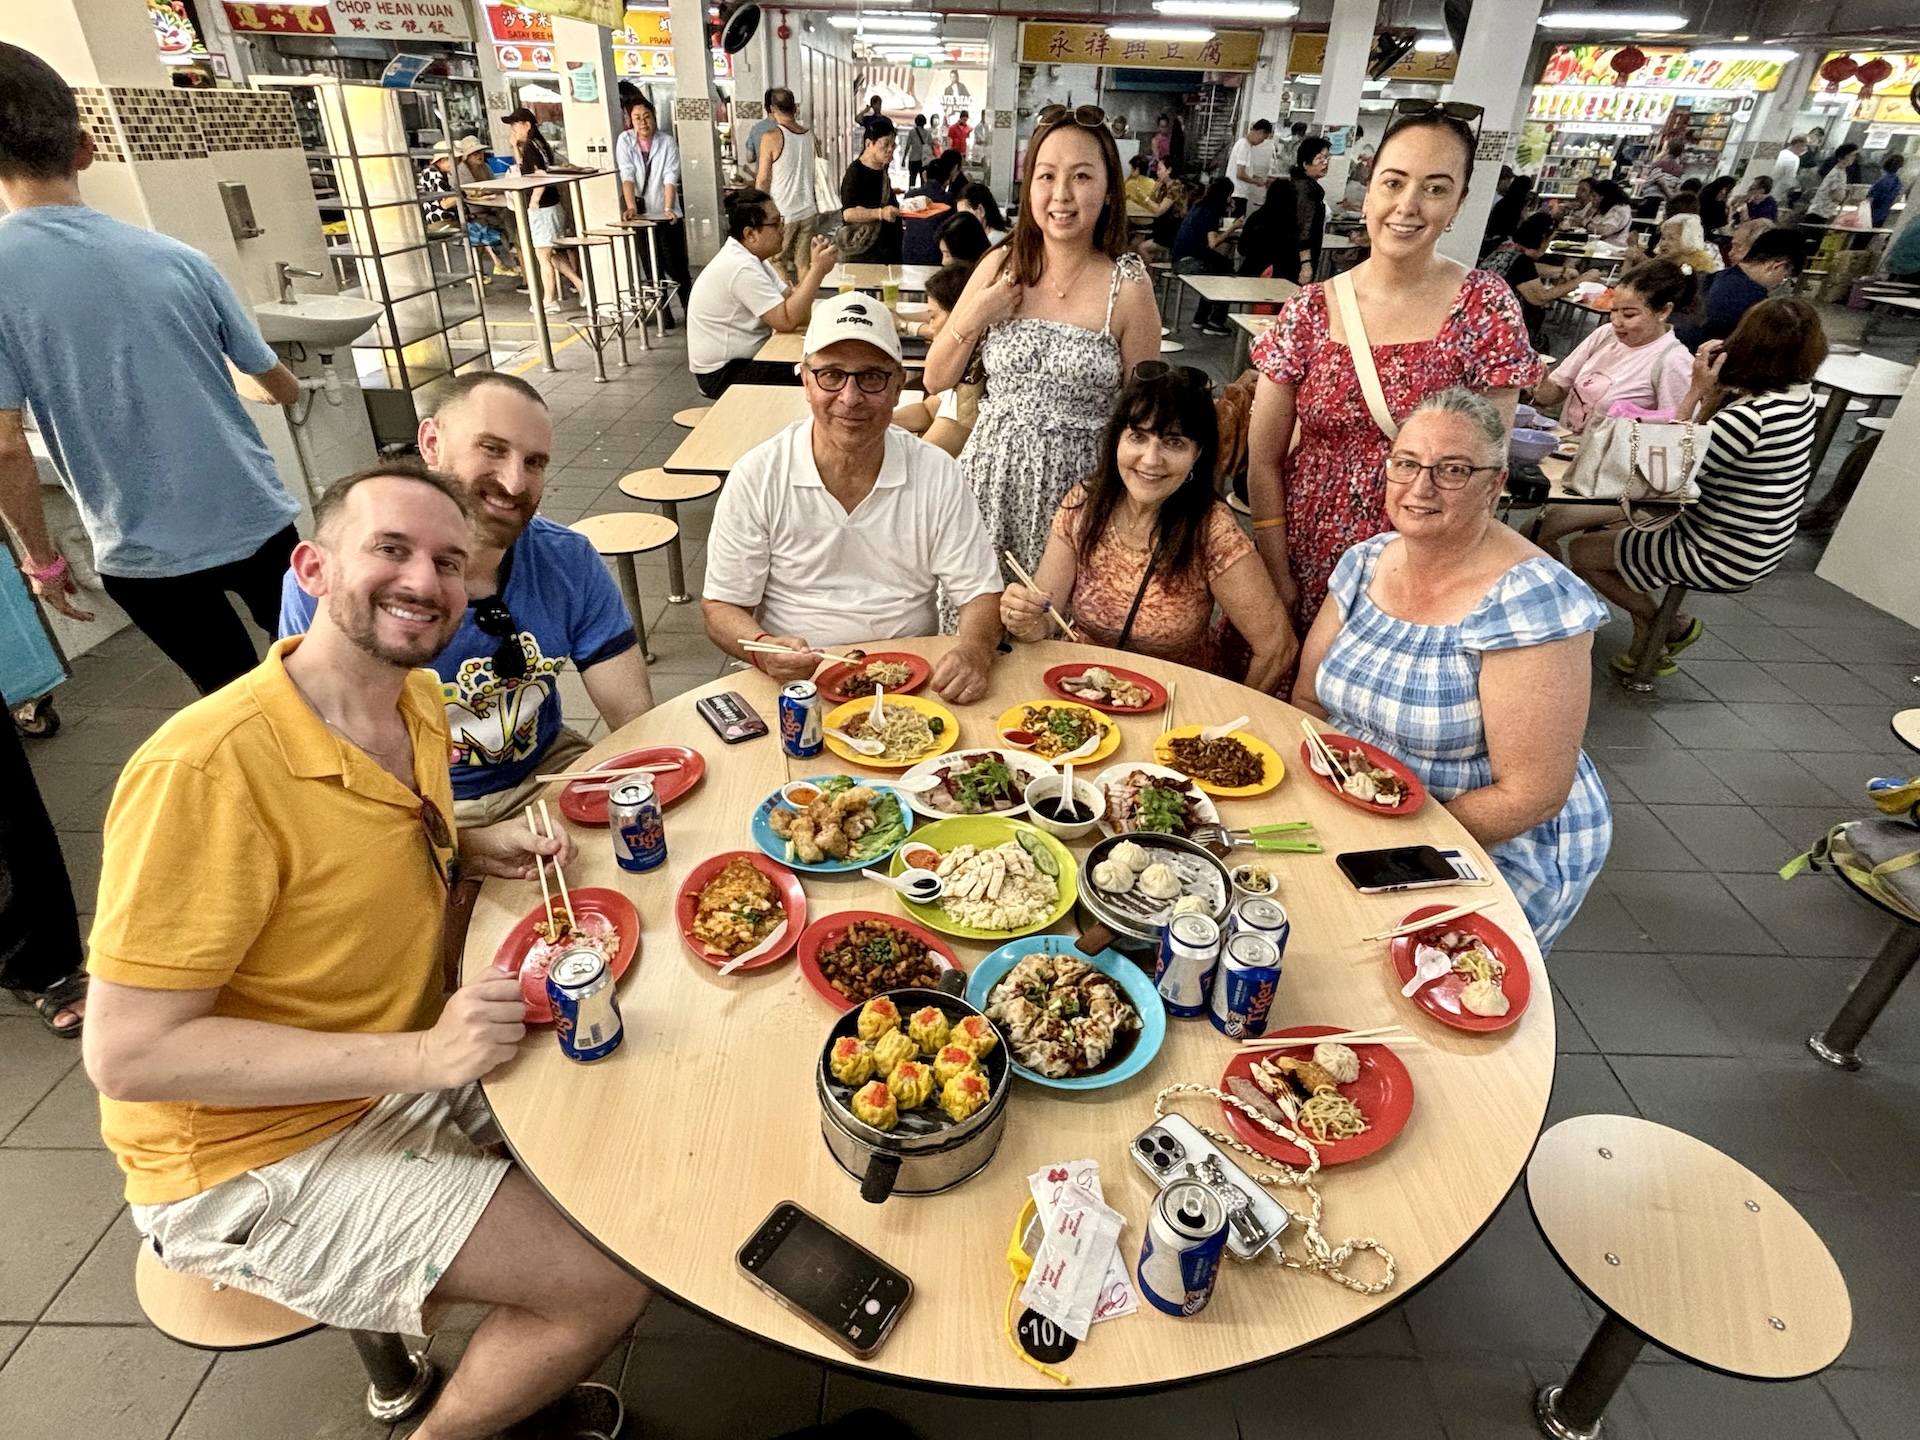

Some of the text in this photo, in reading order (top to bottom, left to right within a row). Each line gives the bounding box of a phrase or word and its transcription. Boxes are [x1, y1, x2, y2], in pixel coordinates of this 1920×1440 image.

[336, 0, 454, 17] CHOP HEAN KUAN
[507, 31, 529, 39] SATAY
[531, 32, 546, 40] BEE
[915, 58, 927, 67] EXIT
[782, 706, 802, 742] Tiger
[626, 824, 662, 850] Tige
[1246, 980, 1273, 1025] Tiger
